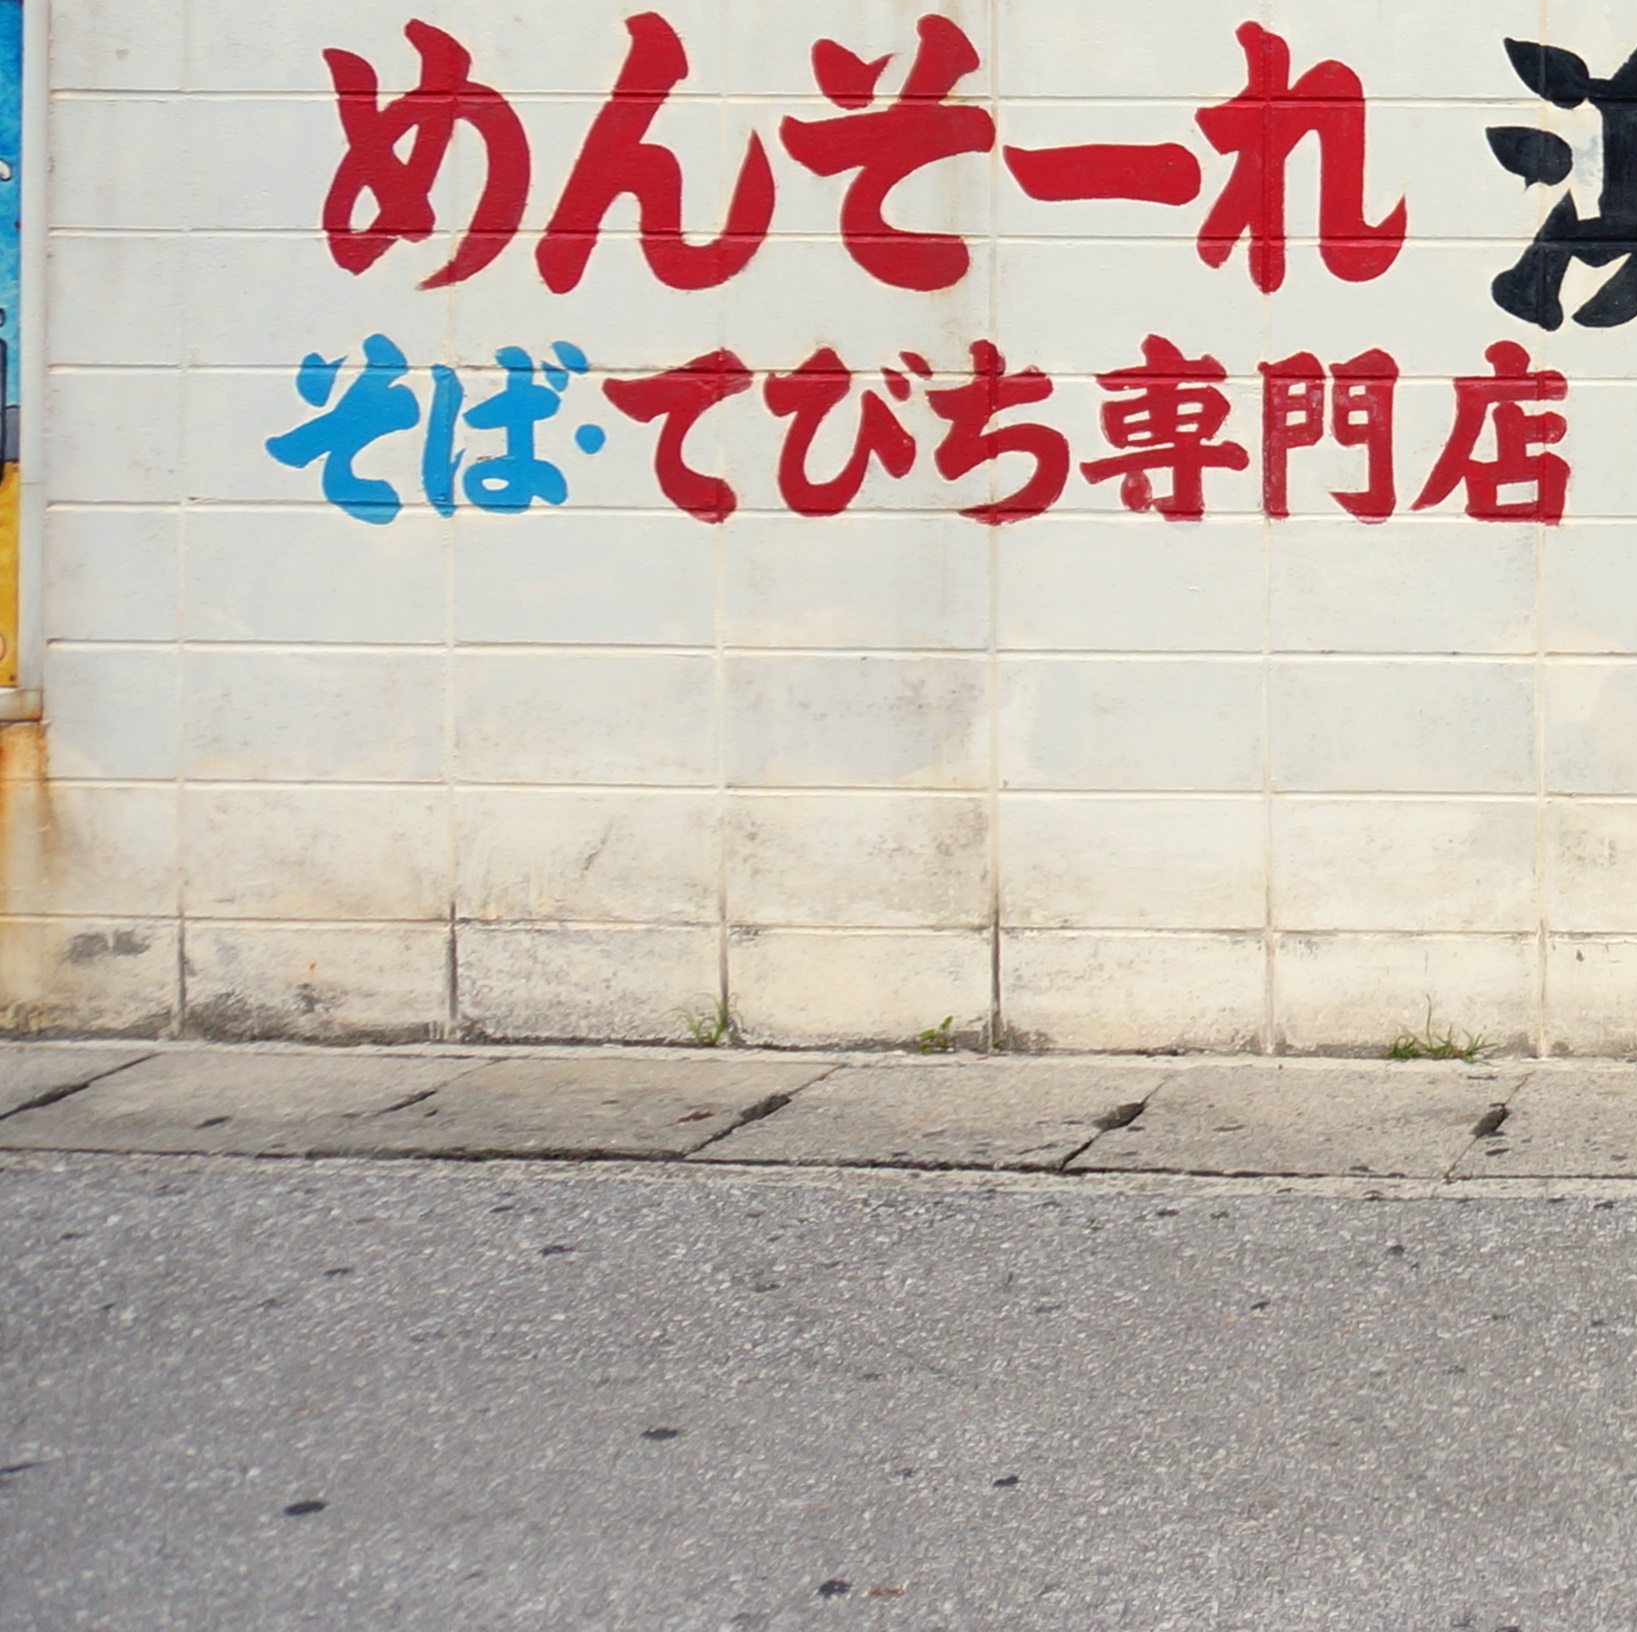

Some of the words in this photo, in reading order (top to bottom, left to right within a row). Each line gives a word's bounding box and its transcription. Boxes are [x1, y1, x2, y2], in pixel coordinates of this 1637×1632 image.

[322, 12, 1407, 294] めんそーれ
